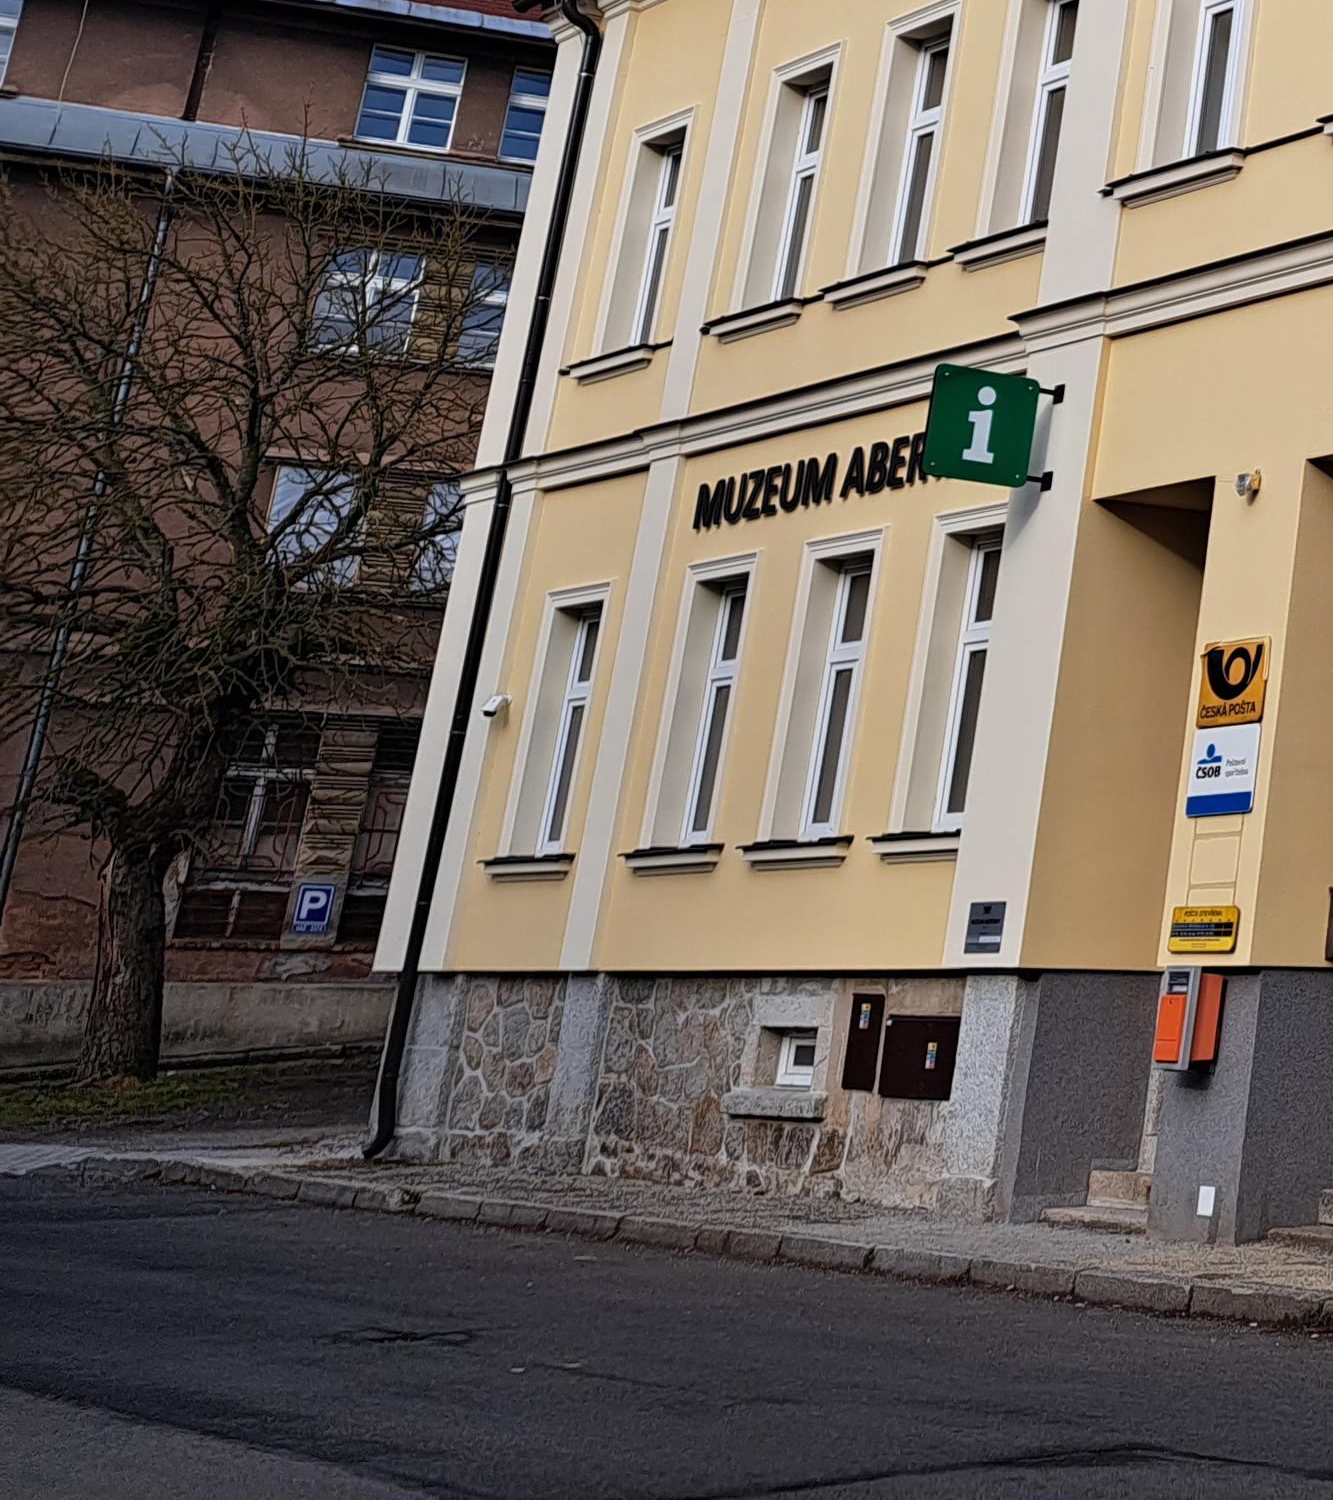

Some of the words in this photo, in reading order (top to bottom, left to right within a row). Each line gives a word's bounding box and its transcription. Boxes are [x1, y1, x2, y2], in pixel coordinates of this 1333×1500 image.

[692, 452, 838, 531] MUZEUM
[839, 431, 929, 499] ABER
[1200, 702, 1228, 719] ČESKÁ
[1228, 700, 1257, 716] POŠTA
[1195, 765, 1222, 779] ČSOB
[299, 890, 328, 920] P
